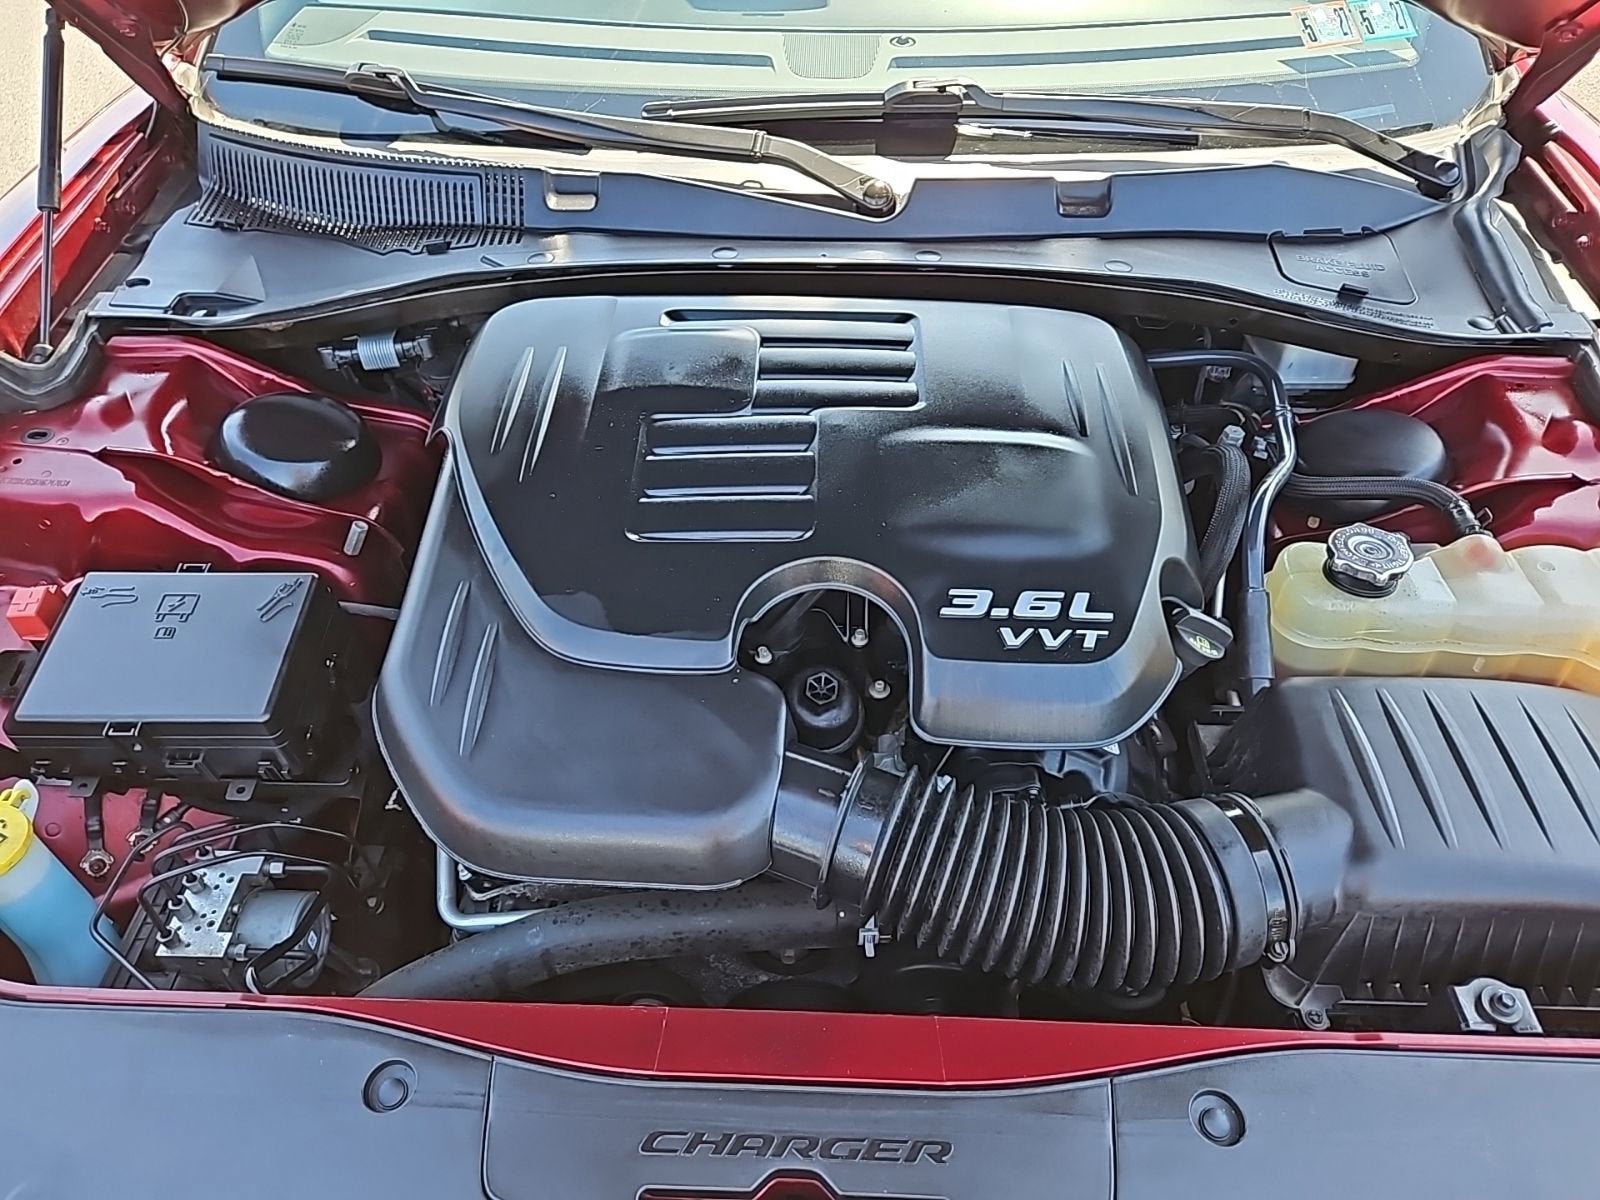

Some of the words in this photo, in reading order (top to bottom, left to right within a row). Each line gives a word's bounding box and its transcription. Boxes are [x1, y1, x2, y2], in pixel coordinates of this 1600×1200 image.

[1296, 254, 1343, 267] BRAKE
[1344, 260, 1386, 272] FLUID
[1315, 265, 1370, 278] ACCESS
[939, 588, 1114, 622] 3.6L
[998, 627, 1110, 651] VVT
[638, 1130, 955, 1165] CHARGER
